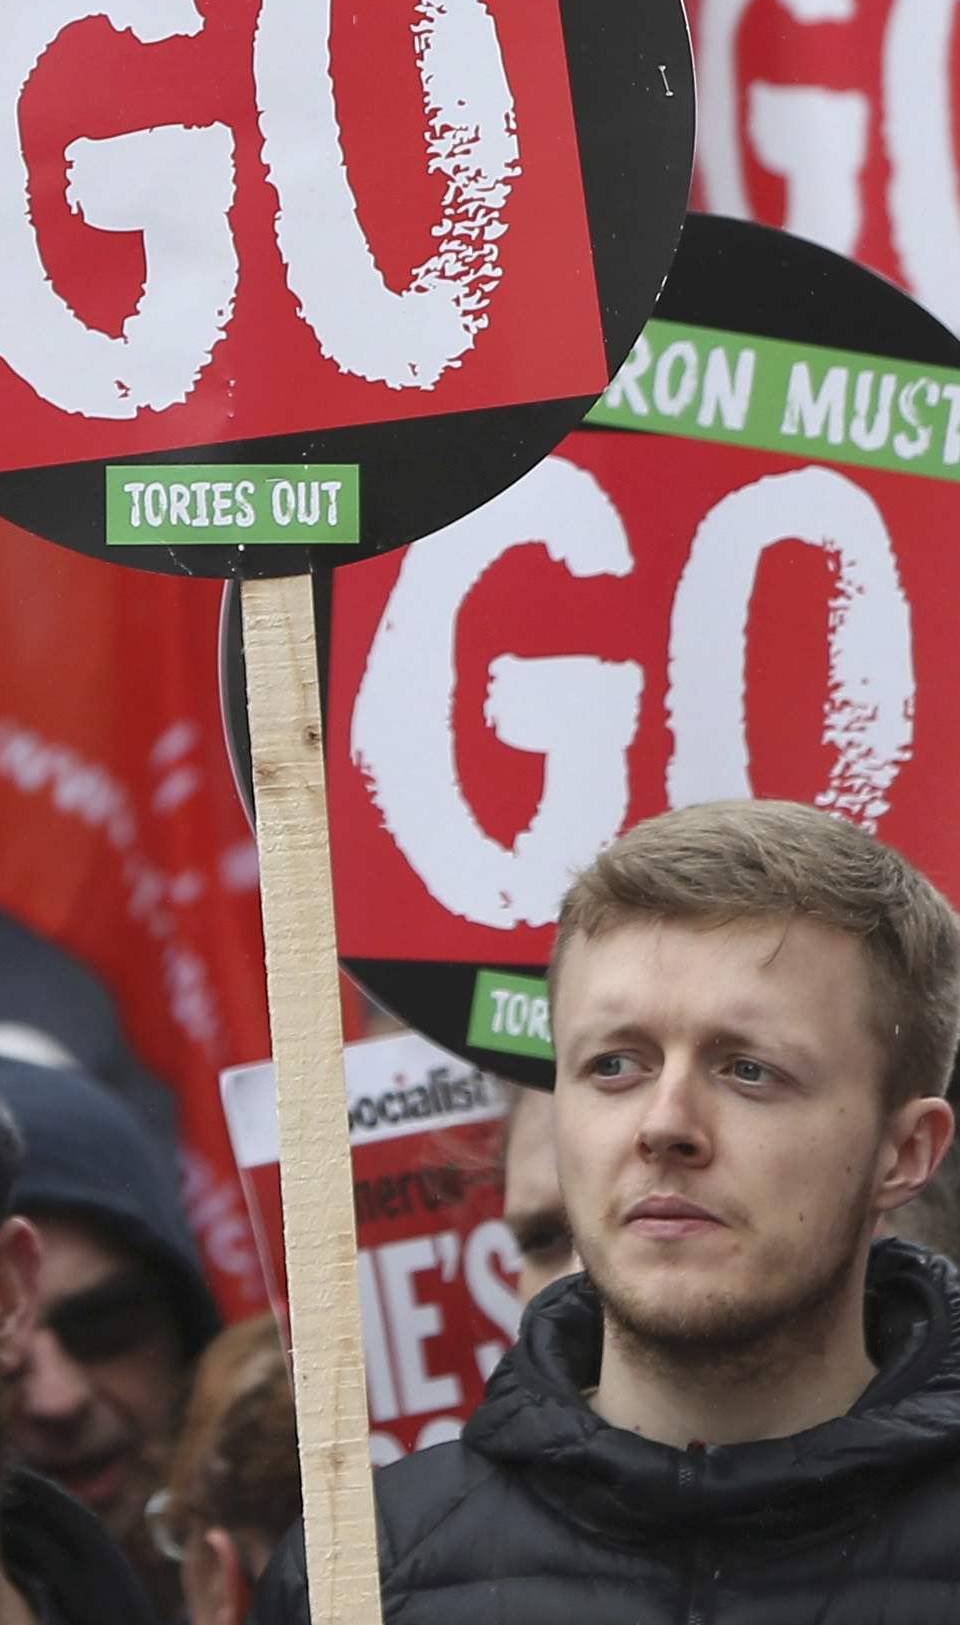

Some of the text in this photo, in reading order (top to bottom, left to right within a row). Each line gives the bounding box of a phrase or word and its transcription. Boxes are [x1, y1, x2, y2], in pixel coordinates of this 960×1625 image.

[123, 478, 342, 527] TORIES OUT
[349, 464, 917, 930] GO
[348, 1066, 492, 1131] ocialist
